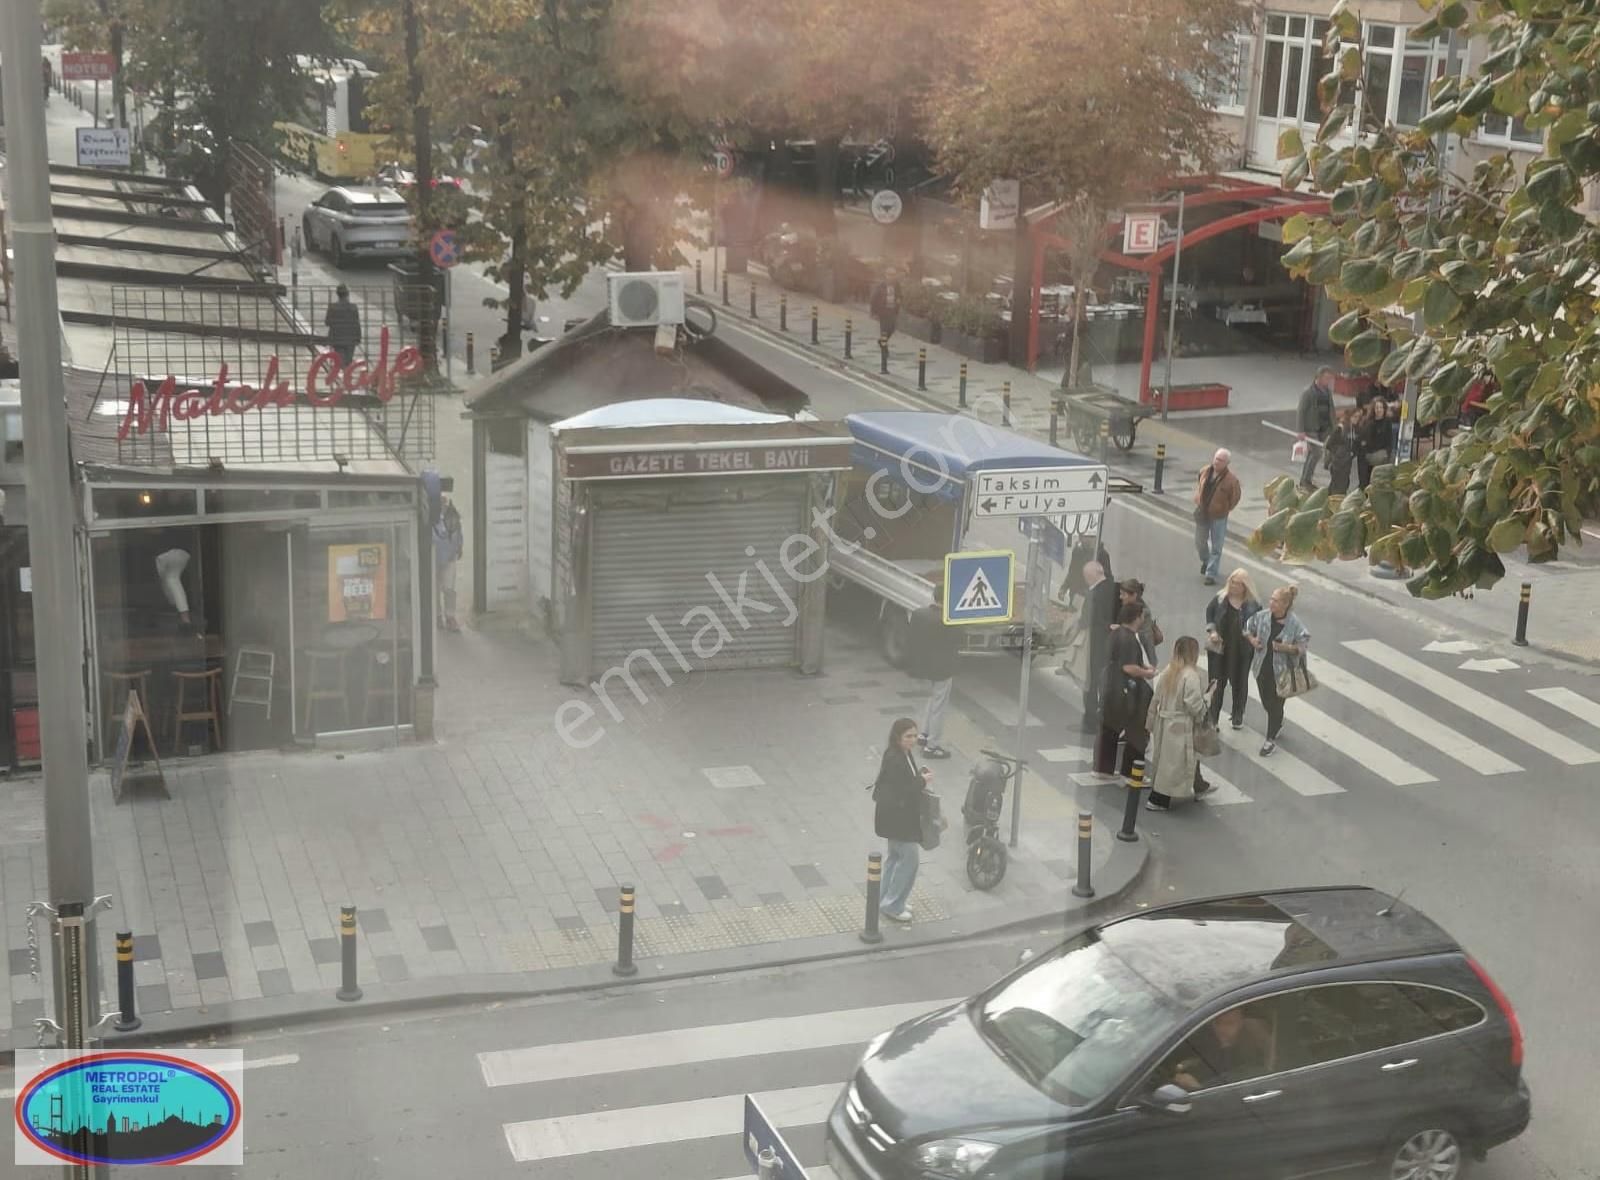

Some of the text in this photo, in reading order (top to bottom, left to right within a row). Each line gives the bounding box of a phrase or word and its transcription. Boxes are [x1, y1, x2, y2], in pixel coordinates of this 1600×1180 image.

[1134, 222, 1150, 246] E
[115, 325, 423, 442] Match Cafe
[609, 453, 685, 474] GAZETE
[696, 451, 754, 470] TEKEL
[983, 476, 1060, 491] Taksim
[1004, 495, 1067, 512] Fulya
